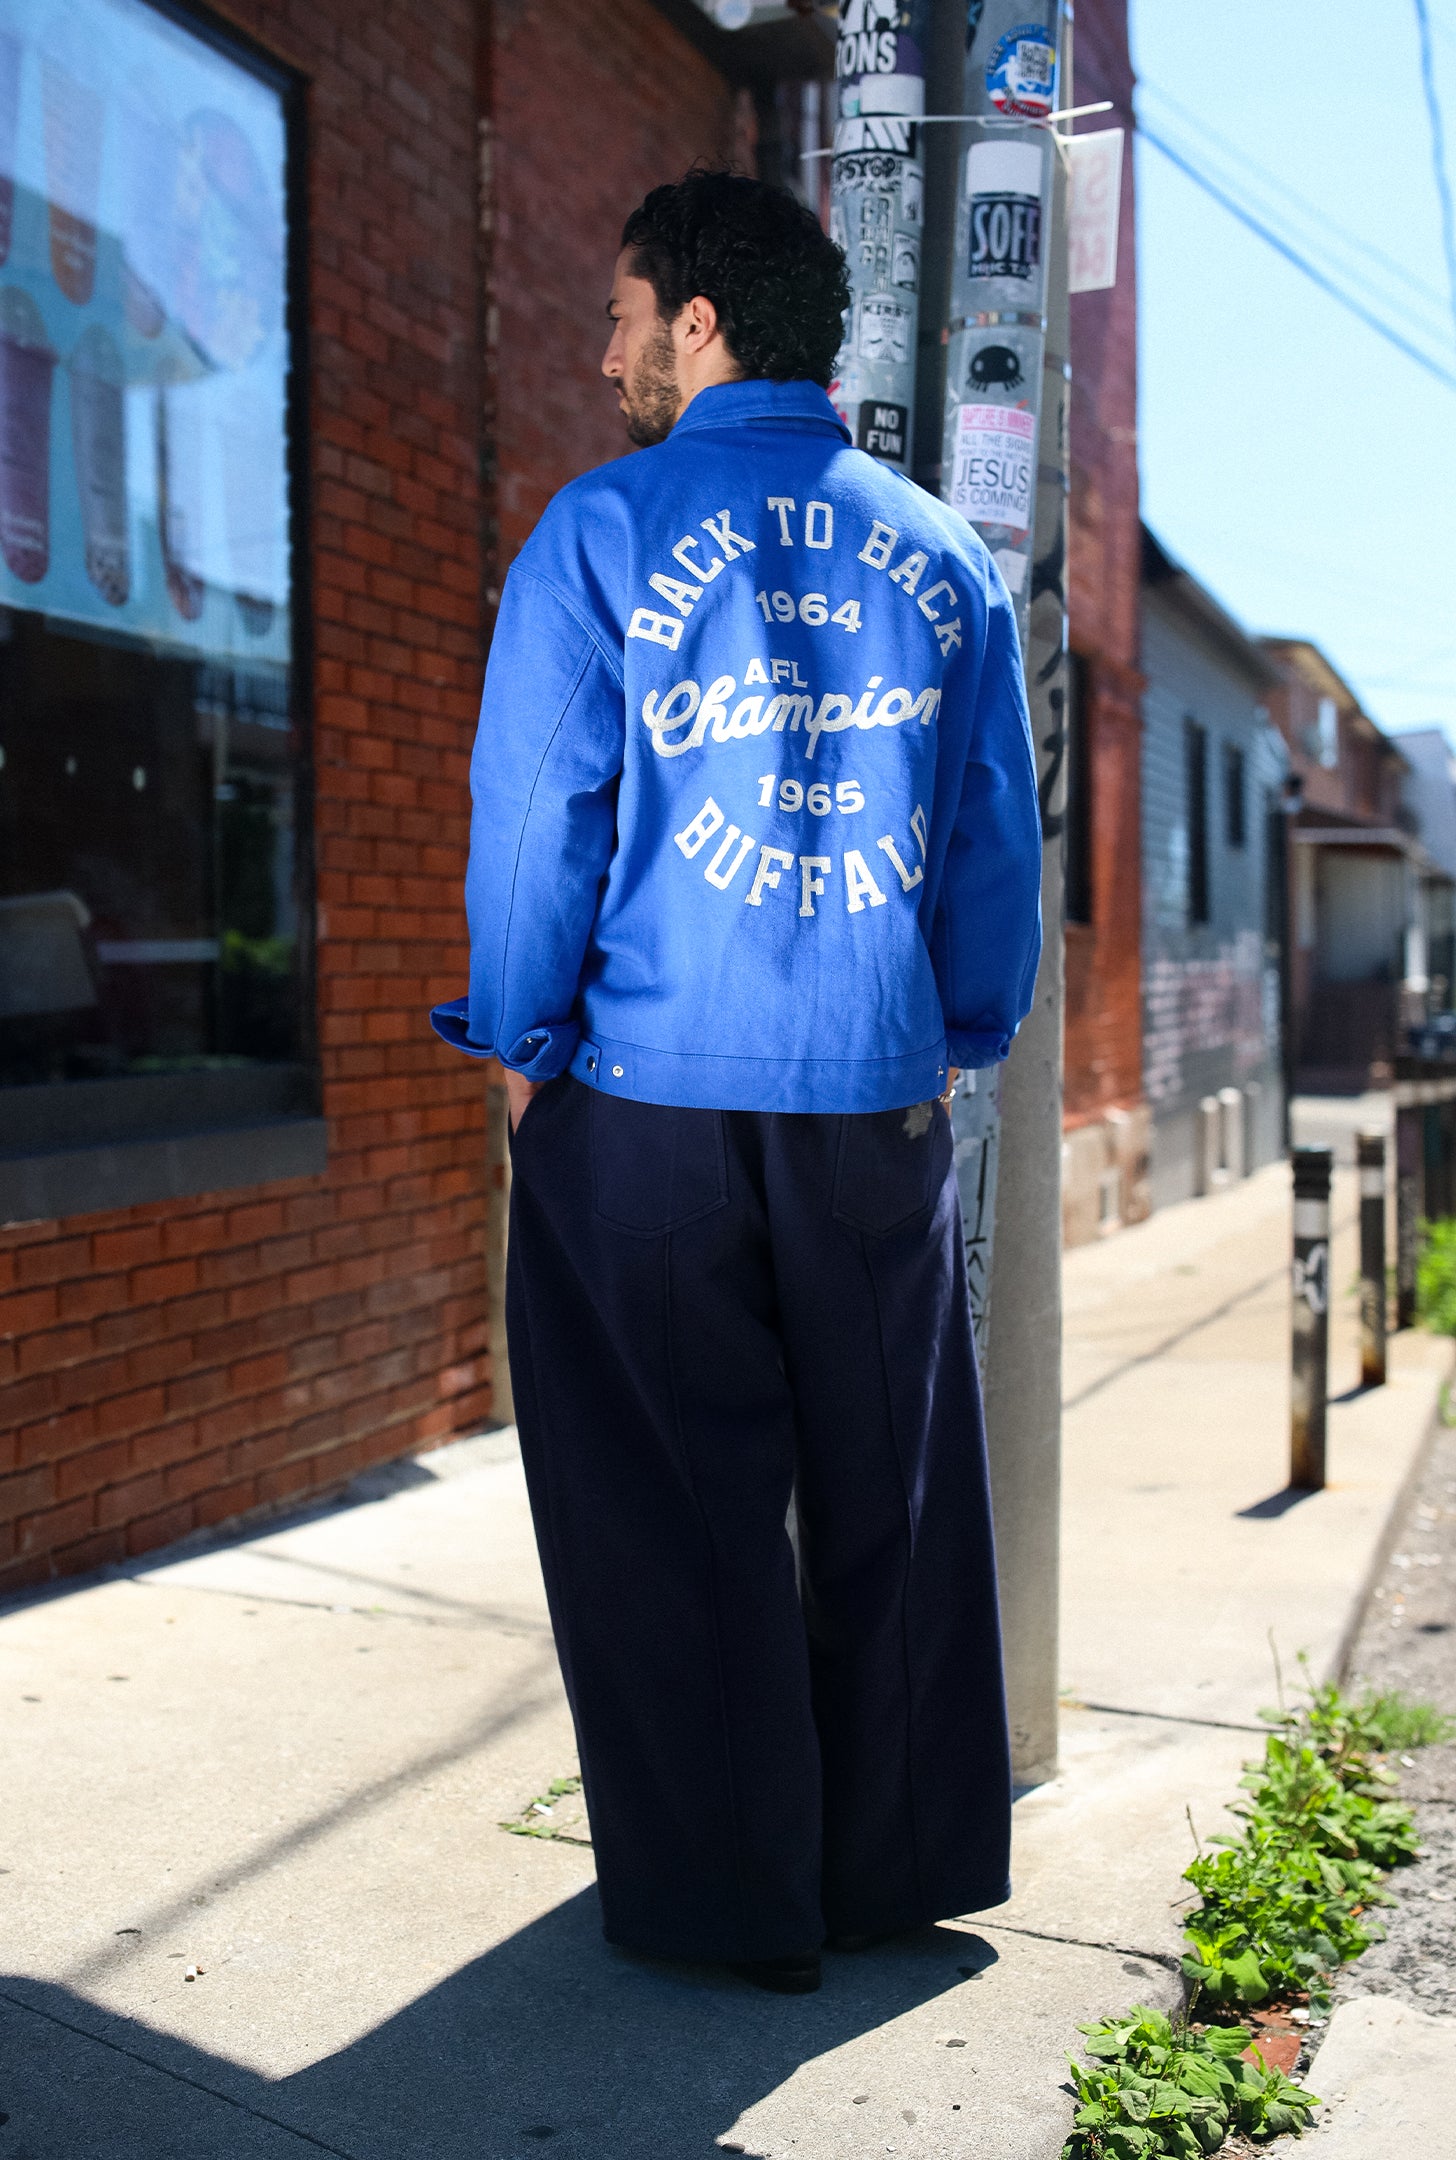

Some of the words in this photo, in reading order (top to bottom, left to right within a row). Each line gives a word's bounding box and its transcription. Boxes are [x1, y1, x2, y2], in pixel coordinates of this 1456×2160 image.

[874, 407, 899, 430] NO
[867, 430, 902, 453] FUN
[958, 458, 1028, 494] JESUS
[627, 509, 756, 651] BACK
[767, 496, 834, 549] TO
[856, 519, 963, 657] BACK
[756, 590, 862, 633] 1964
[743, 658, 808, 688] AFL
[757, 774, 865, 817] 1965
